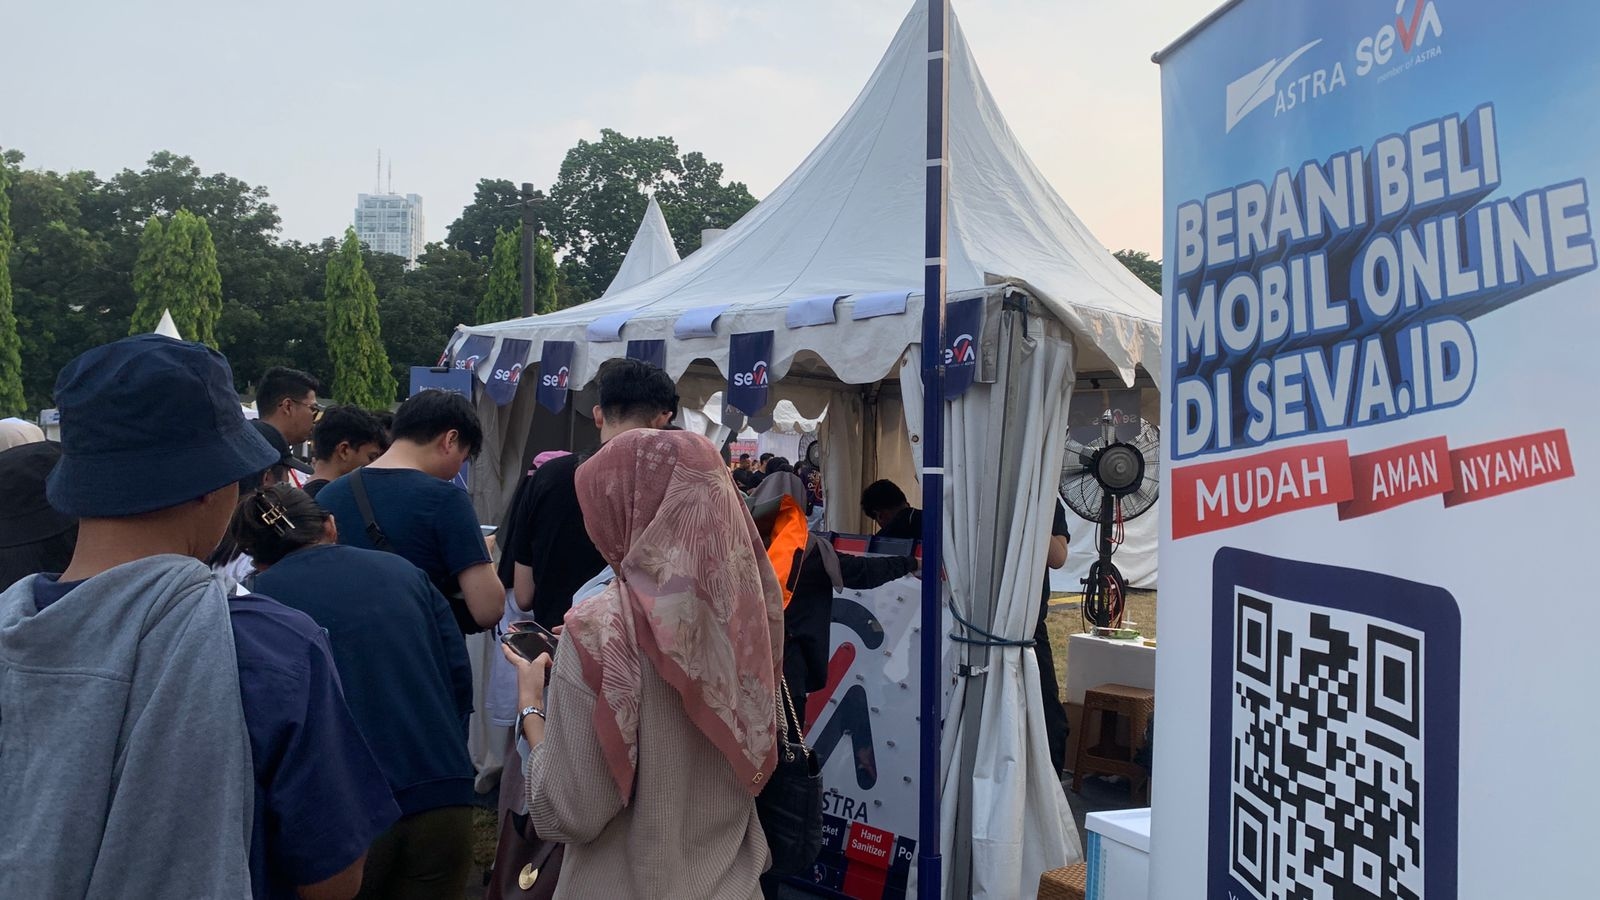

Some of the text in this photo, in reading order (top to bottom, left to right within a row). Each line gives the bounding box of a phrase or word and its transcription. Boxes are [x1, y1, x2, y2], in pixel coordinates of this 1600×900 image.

[1415, 46, 1442, 65] ASTRA
[1274, 62, 1346, 117] ASTRA
[1177, 103, 1500, 277] BERANI BELI
[1176, 182, 1596, 364] MOBIL ONLINE
[1176, 318, 1475, 456] DI SEVA.ID
[1196, 440, 1561, 521] MUDAH AMAN NYAMAN
[822, 791, 868, 823] STRA
[822, 826, 838, 836] cket
[852, 839, 886, 858] Sanitizer
[860, 829, 882, 843] Hand
